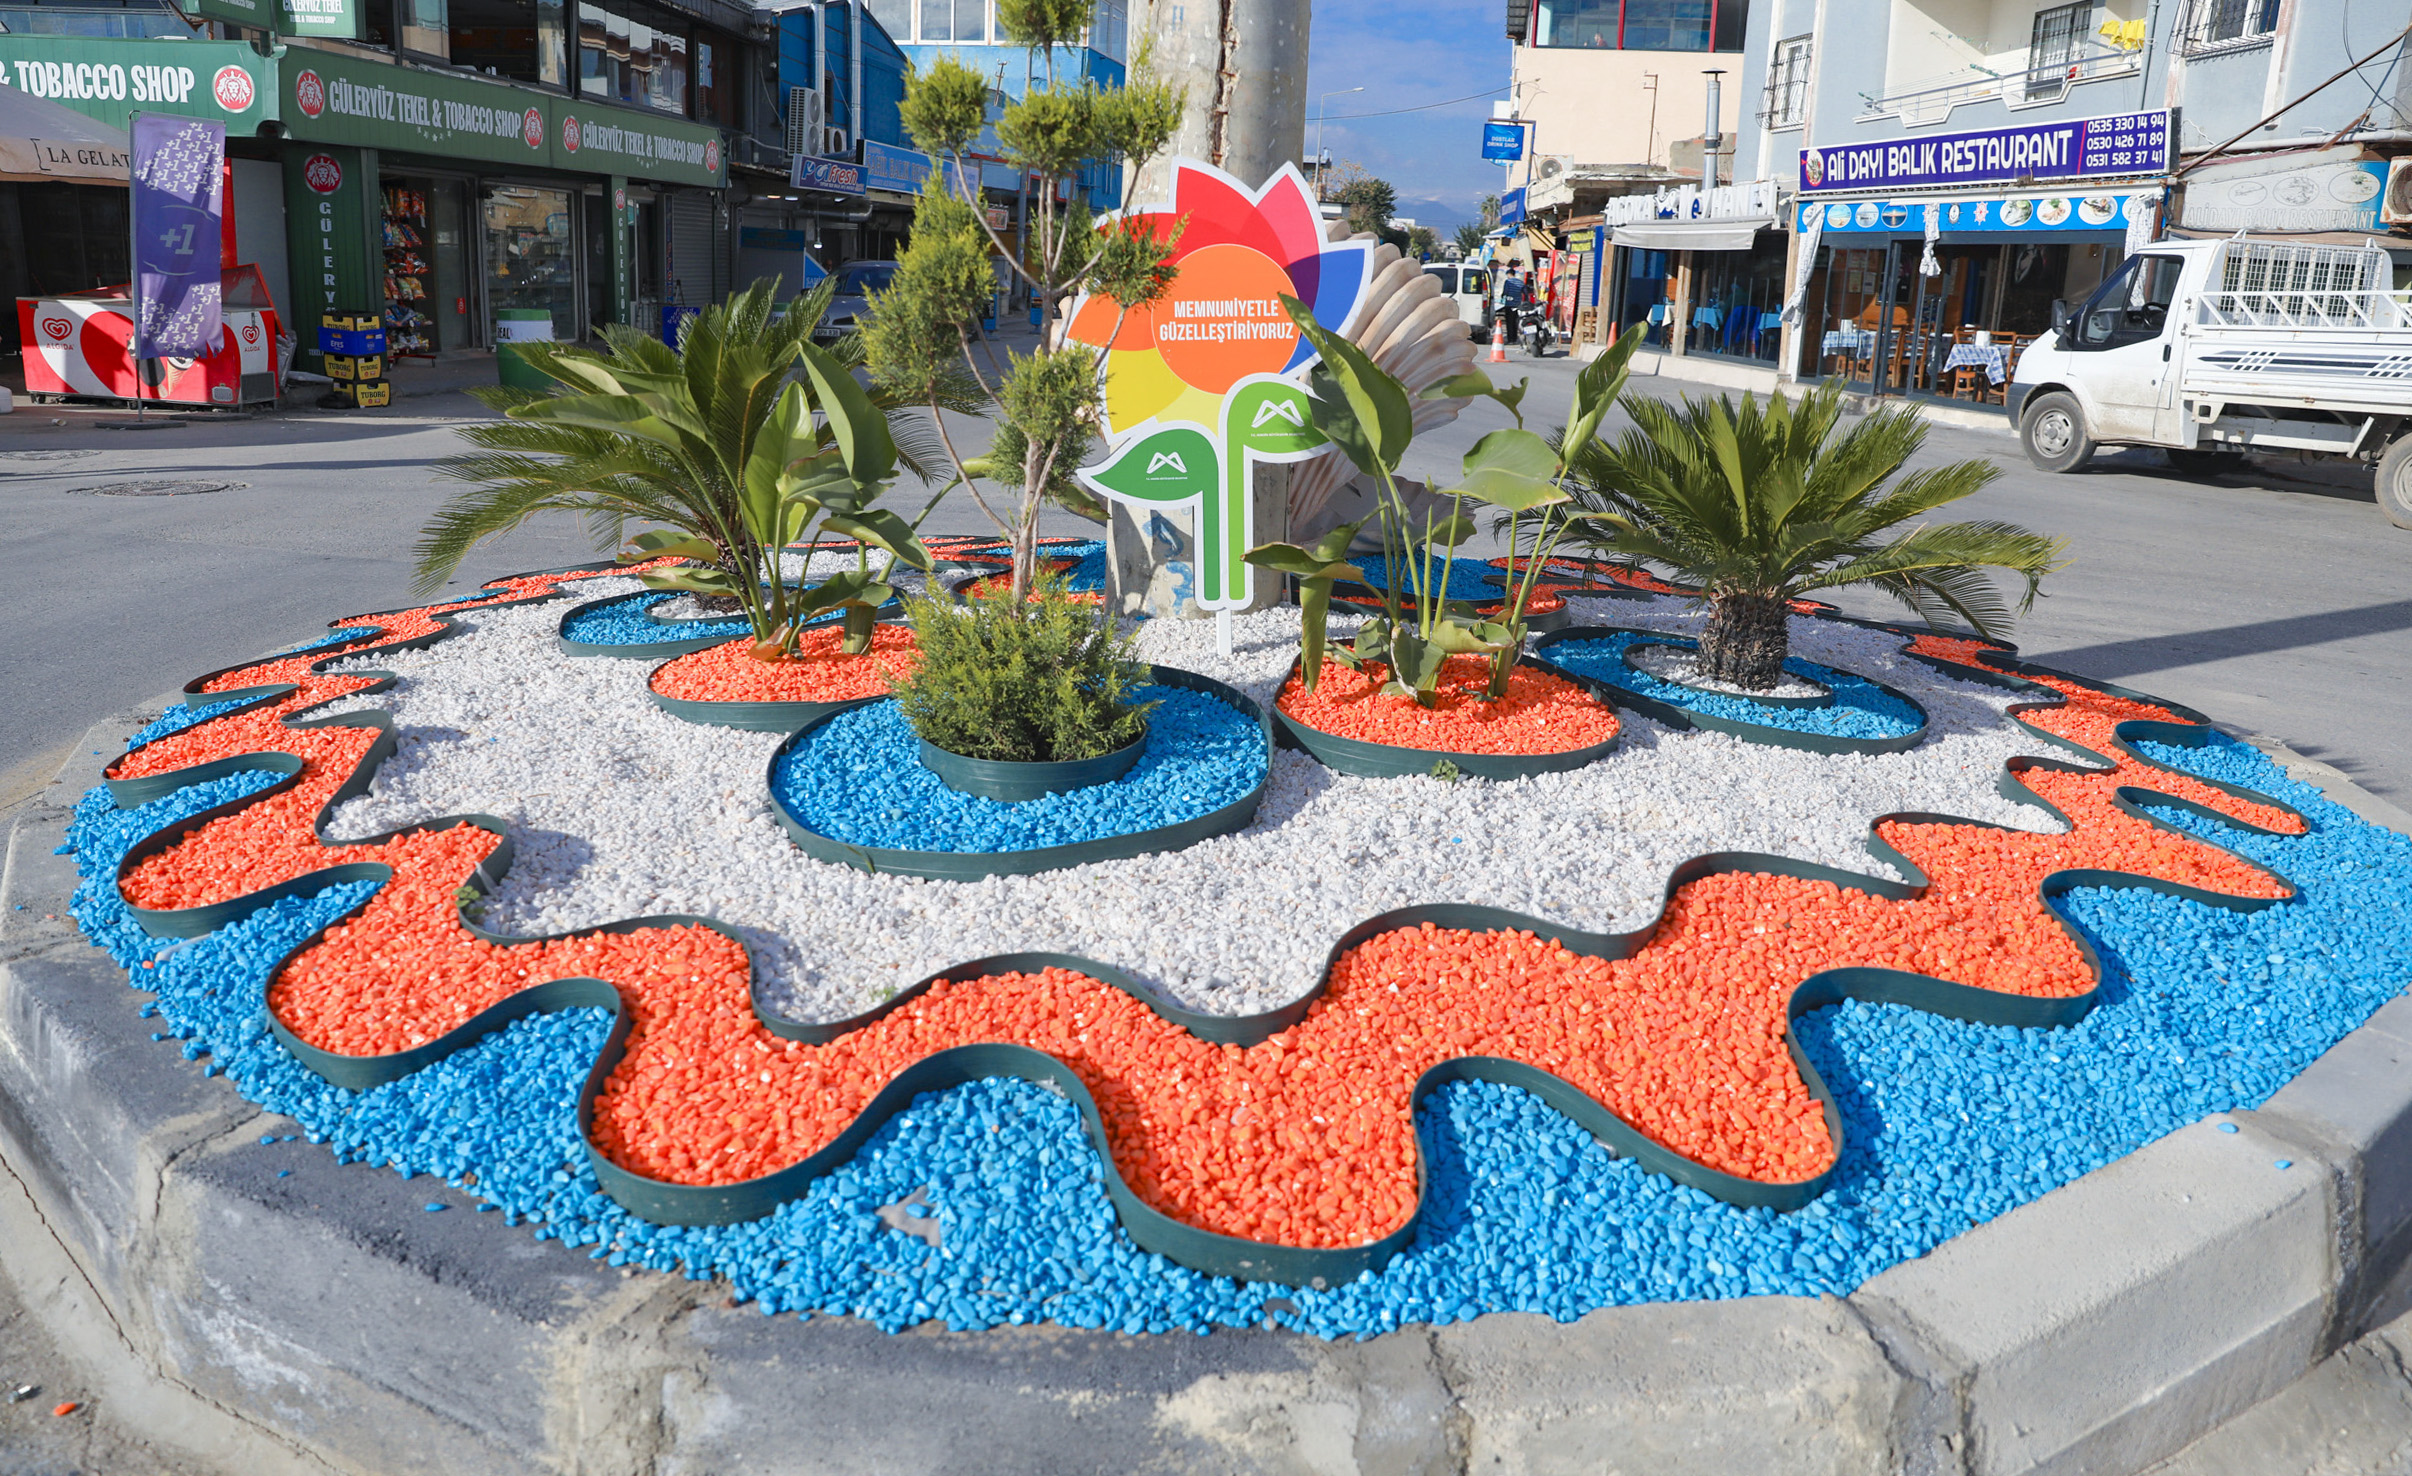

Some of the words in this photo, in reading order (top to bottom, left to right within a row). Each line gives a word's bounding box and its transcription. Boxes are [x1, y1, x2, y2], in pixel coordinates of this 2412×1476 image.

[322, 0, 344, 13] TEKEL
[14, 61, 127, 100] TOBACCO
[131, 65, 195, 103] SHOP
[329, 78, 395, 121] GÜLERYÜZ
[396, 92, 431, 126] TEKEL
[432, 99, 442, 128] &
[444, 100, 493, 135] TOBACCO
[495, 109, 521, 138] SHOP
[2087, 119, 2113, 134] 0535
[2114, 116, 2135, 131] 330
[2137, 115, 2148, 129] 14
[2150, 113, 2164, 128] 94
[583, 120, 623, 153] GÜLERYÜZ
[624, 131, 645, 156] TEKEL
[647, 135, 653, 157] &
[654, 136, 686, 162] TOBACCO
[687, 142, 705, 165] SHOP
[2086, 136, 2112, 150] 0530
[2114, 134, 2134, 148] 426
[2137, 133, 2147, 146] 71
[2149, 131, 2164, 146] 89
[46, 147, 72, 163] LA
[1849, 148, 1883, 180] DAYI
[1888, 142, 1936, 177] BALIK
[1941, 129, 2073, 174] RESTAURANT
[2086, 153, 2108, 167] 0531
[2111, 151, 2132, 166] 582
[2135, 150, 2148, 164] 37
[2151, 149, 2163, 163] 41
[2290, 208, 2377, 229] RESTAURANT
[159, 224, 195, 255] +1
[1174, 297, 1279, 318] MEMNUNİYETLE
[1159, 320, 1294, 343] GÜZELLEŞTİRİYORUZ
[330, 340, 344, 348] EFES
[328, 362, 351, 372] TUBORG
[361, 363, 378, 371] TUBORG
